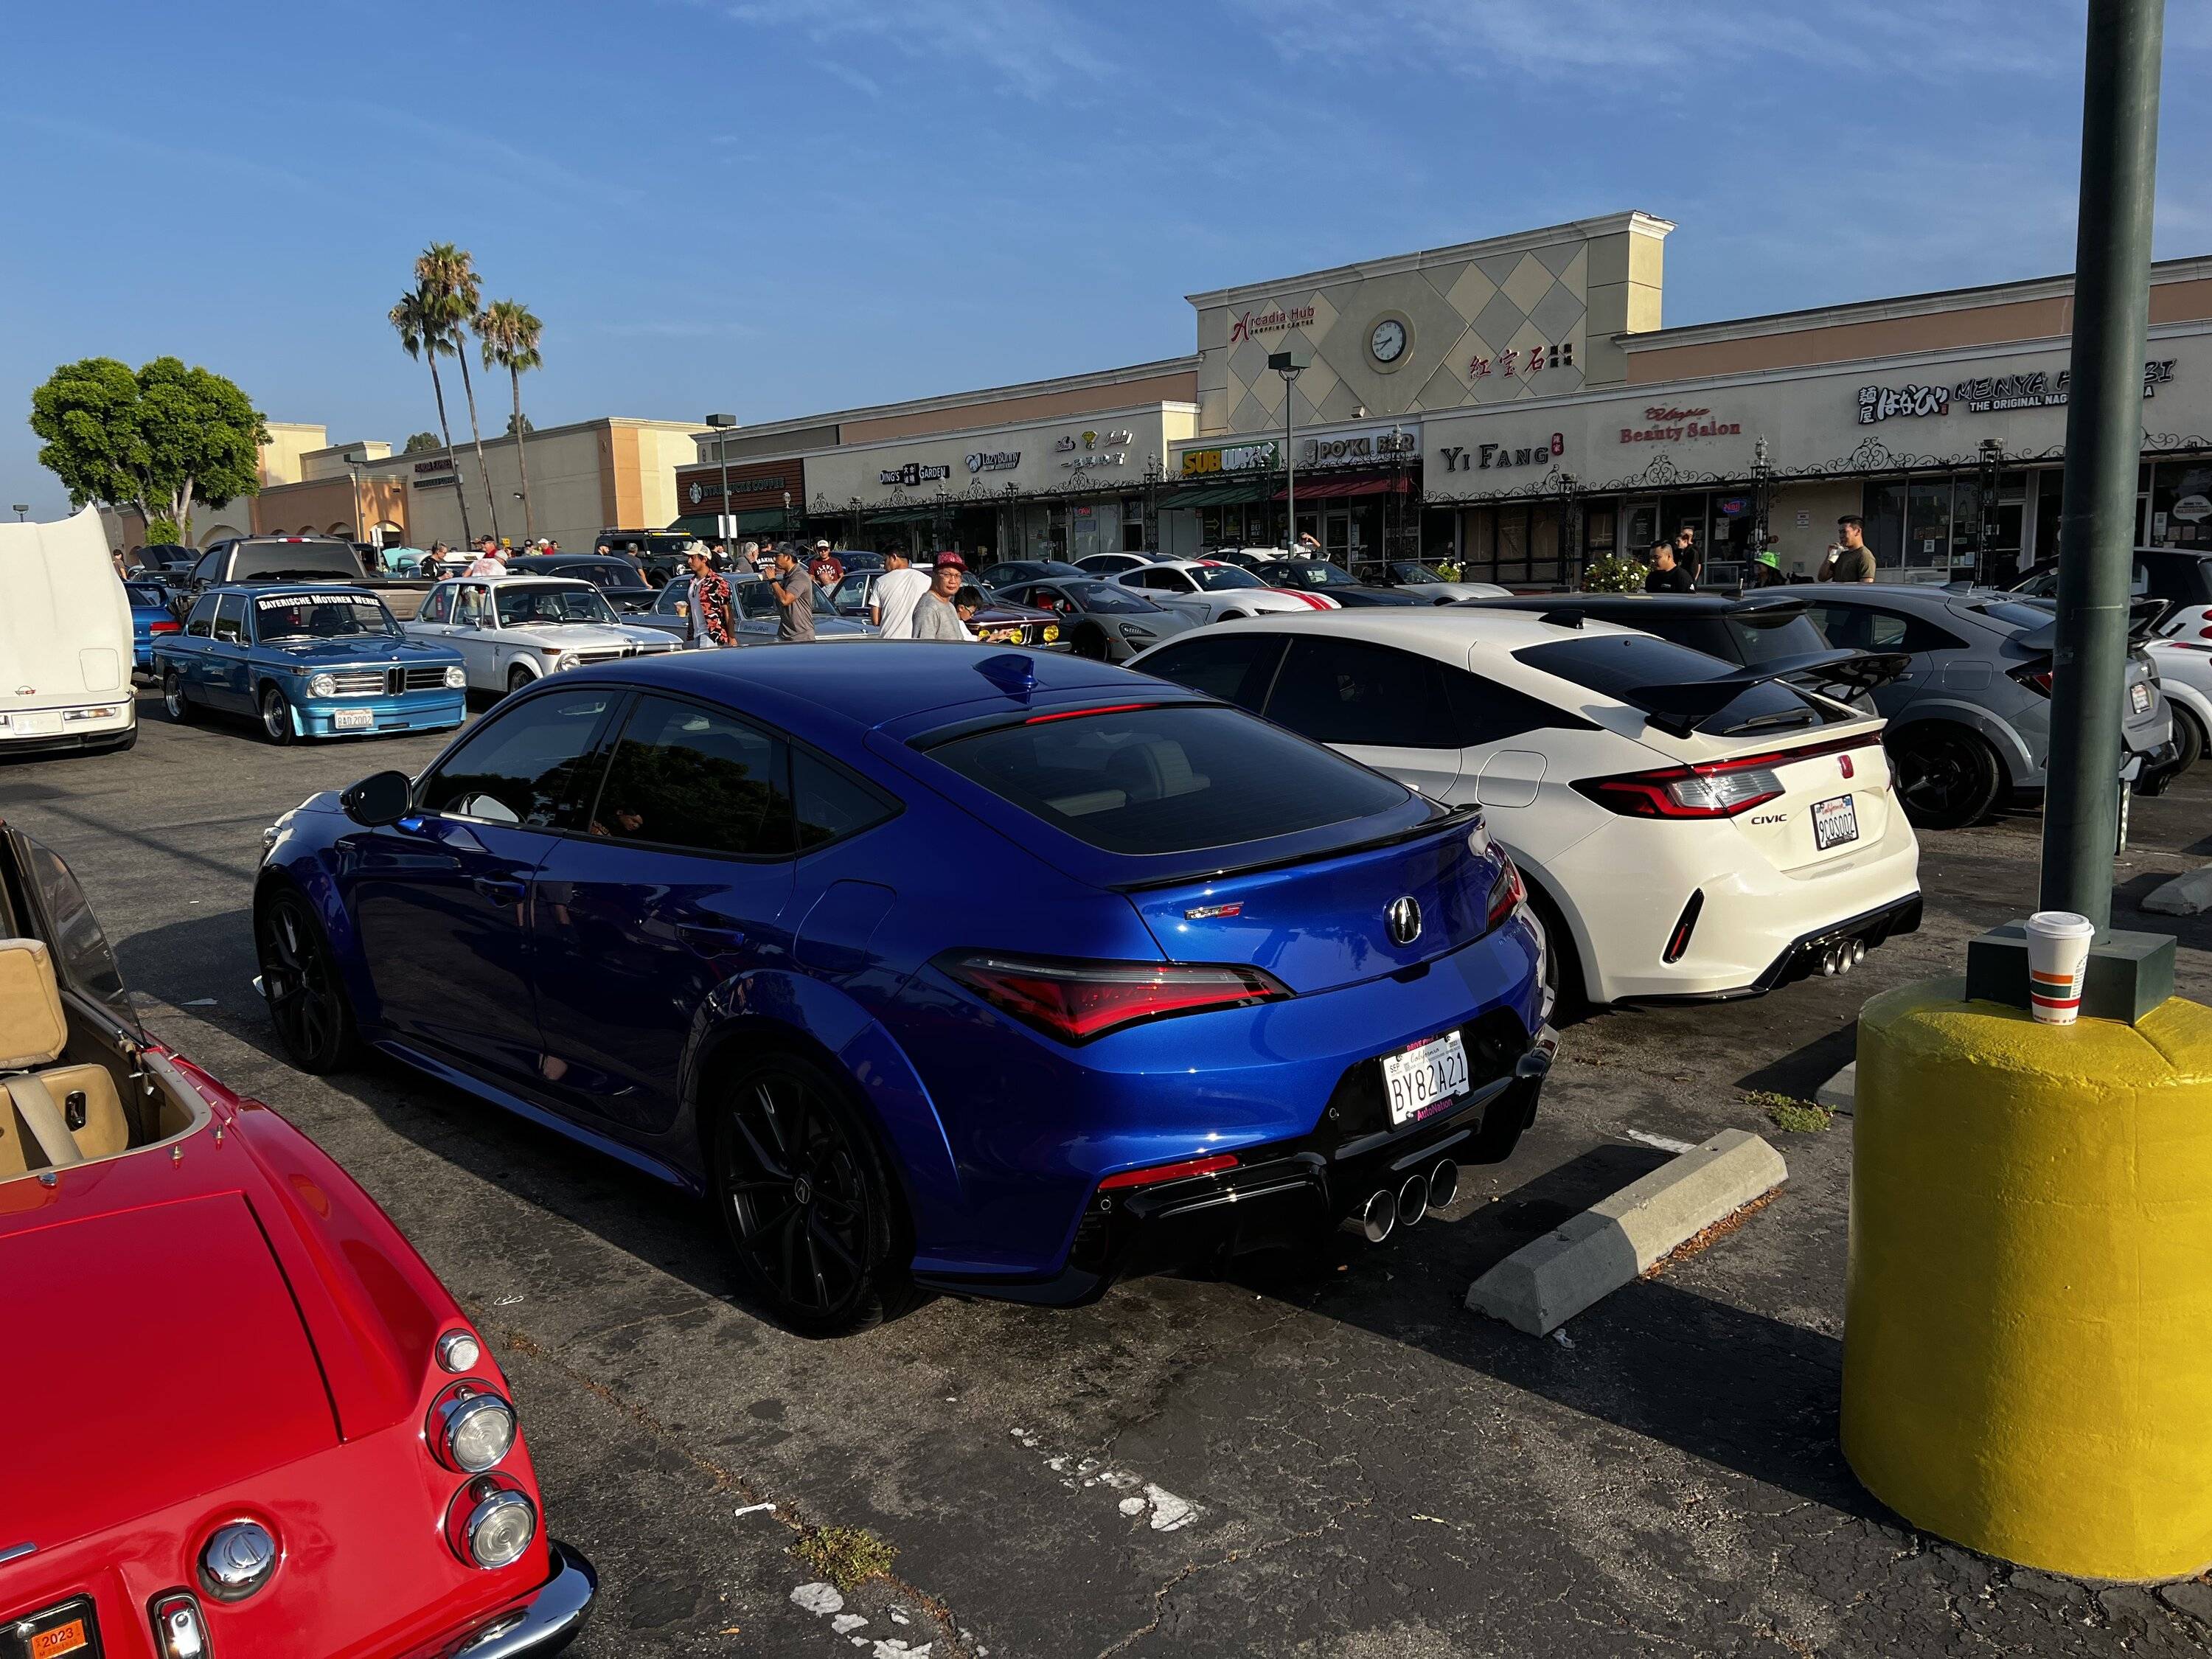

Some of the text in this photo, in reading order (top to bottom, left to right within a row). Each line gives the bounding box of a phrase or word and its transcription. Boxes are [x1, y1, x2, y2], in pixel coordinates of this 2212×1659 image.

[1231, 305, 1315, 341] Arcadia Hub
[1954, 371, 2048, 401] MENYA
[1970, 400, 1990, 412] THE
[1993, 396, 2042, 410] ORIGINAL
[1620, 421, 1741, 443] Beauty Salon
[1478, 443, 1549, 470] FANG
[919, 466, 946, 479] GARDEN
[258, 594, 381, 611] BAYERISCHE MOTOREN WERKE
[1751, 813, 1787, 825] CIVIC
[1406, 1040, 1423, 1051] DRIVE
[1391, 1051, 1467, 1112] BY82A21
[1416, 1098, 1453, 1121] AutoNation
[42, 1627, 74, 1648] 2023
